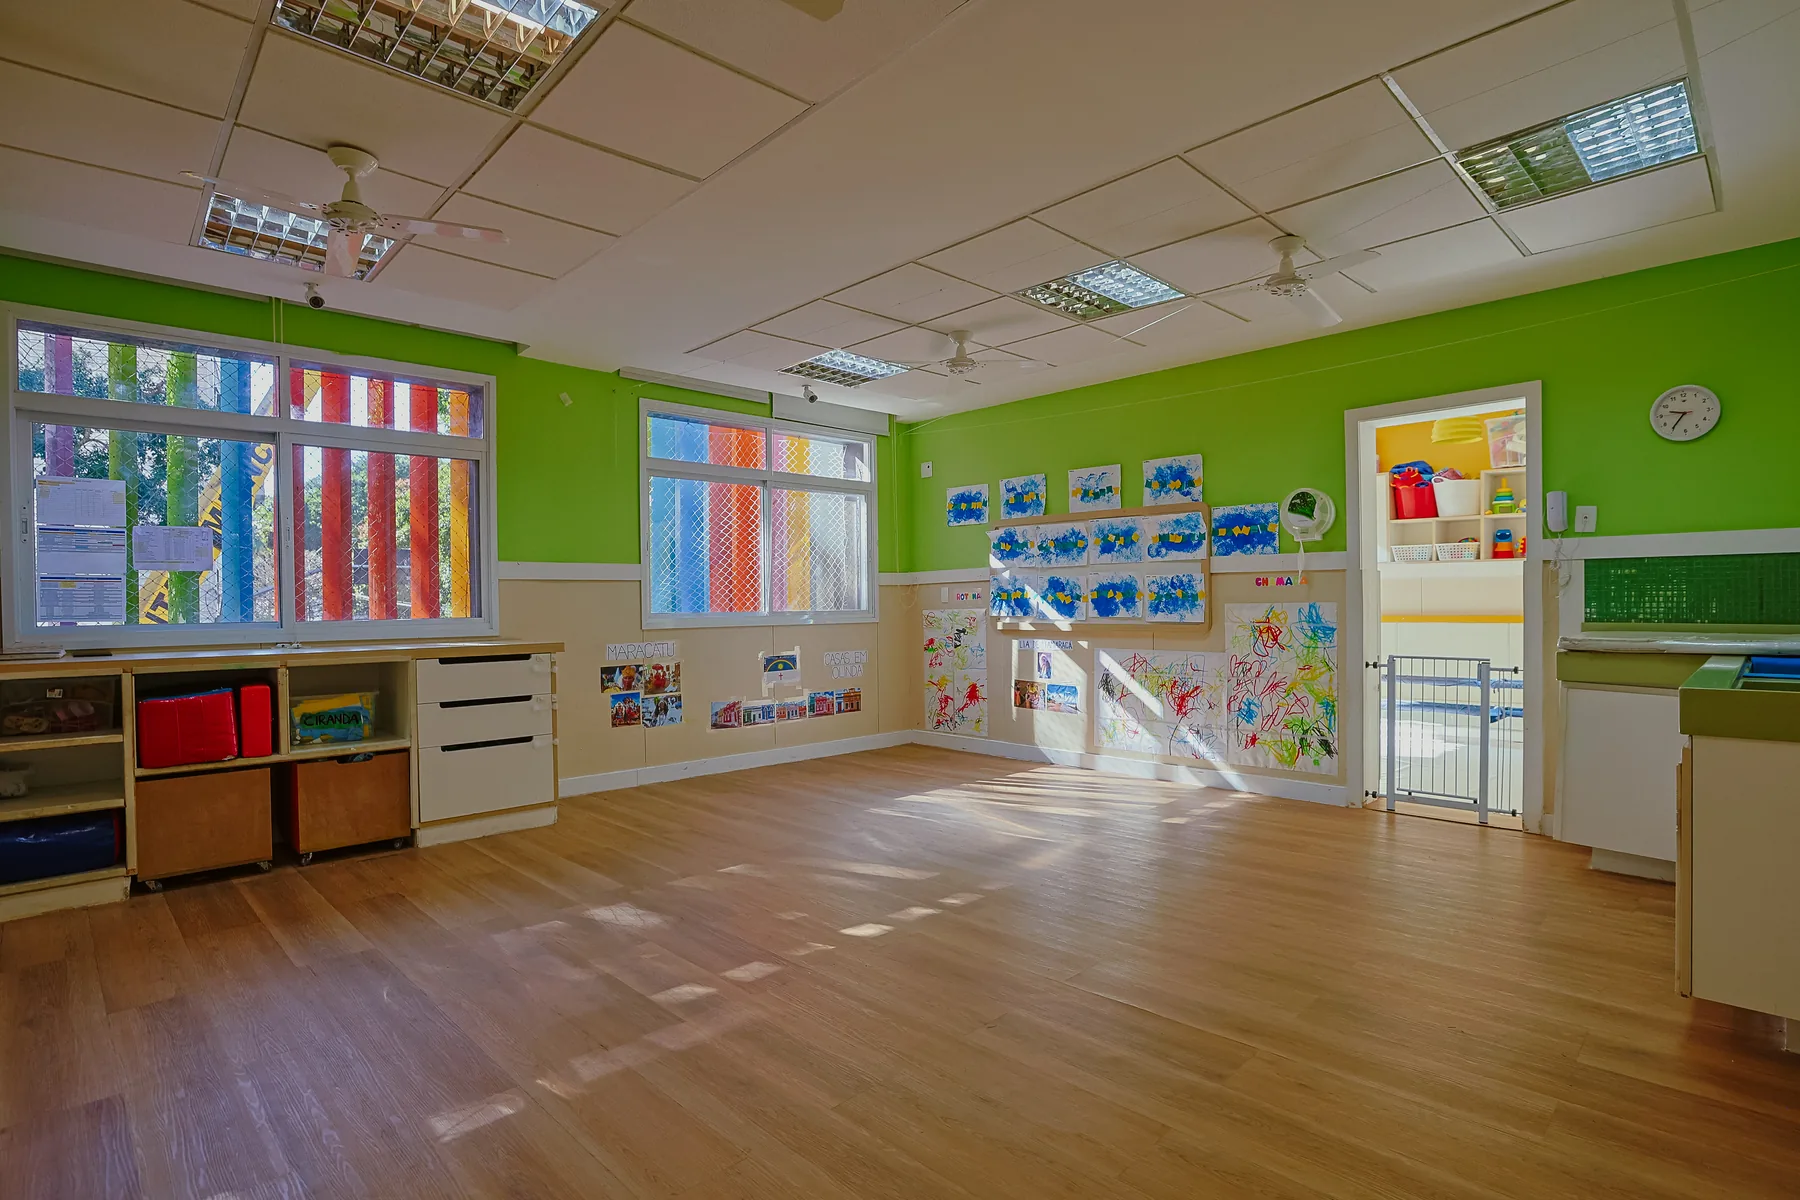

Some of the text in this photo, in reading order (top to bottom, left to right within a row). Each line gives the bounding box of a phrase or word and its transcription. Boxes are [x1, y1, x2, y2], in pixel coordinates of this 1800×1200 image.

[607, 642, 675, 661] MARACATU
[825, 650, 868, 666] CASAS EM
[303, 714, 360, 727] CIRANDA
